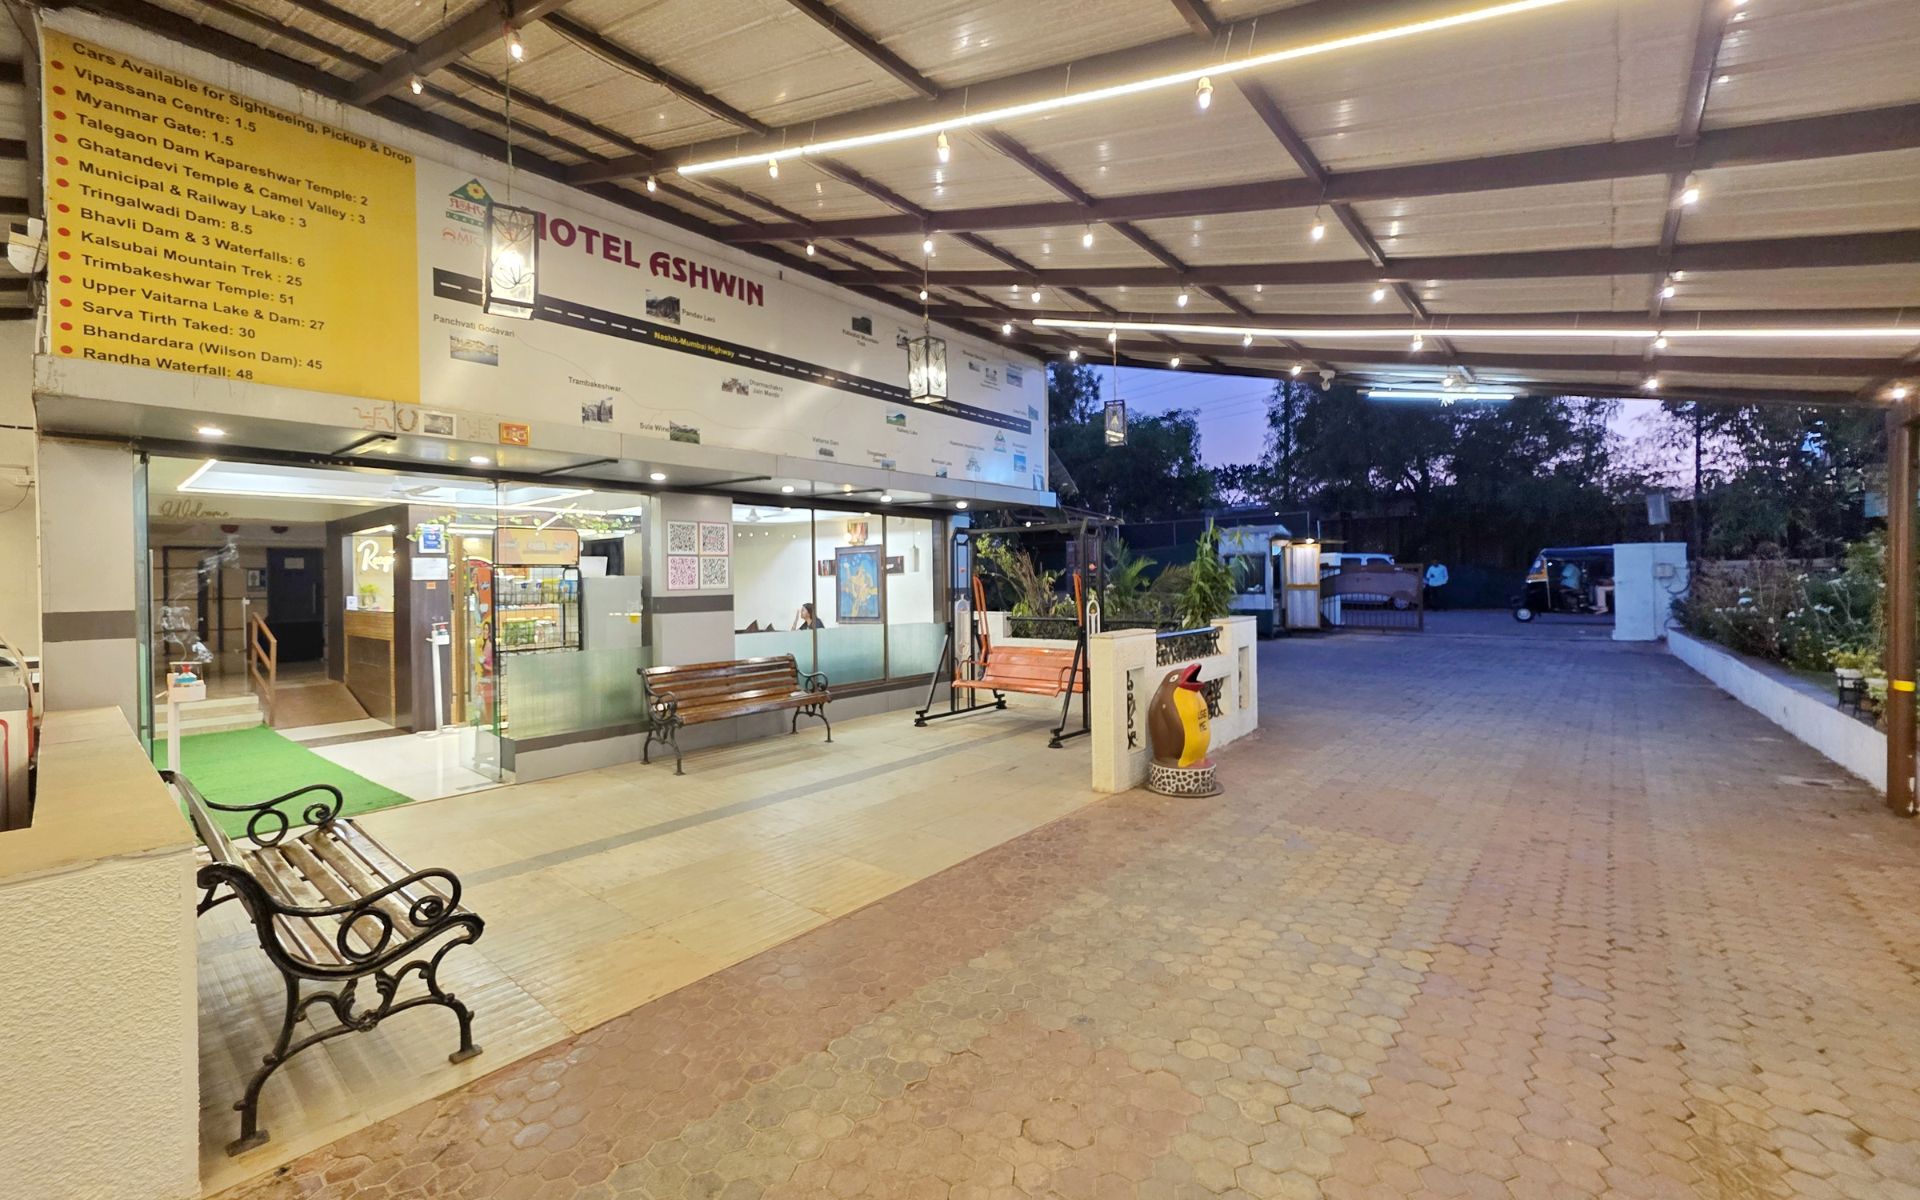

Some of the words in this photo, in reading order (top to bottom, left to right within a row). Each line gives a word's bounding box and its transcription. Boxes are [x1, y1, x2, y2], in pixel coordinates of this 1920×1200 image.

[73, 42, 116, 65] Cars
[121, 59, 198, 92] Available
[202, 86, 225, 101] for
[229, 94, 318, 133] Sightseeing,
[322, 126, 366, 149] Pickup
[370, 142, 379, 152] &
[383, 146, 412, 164] Drop
[74, 66, 167, 104] Vipassana
[172, 98, 229, 124] Centre:
[235, 118, 256, 132] 1.5
[76, 90, 158, 123] Myanmar
[163, 117, 205, 138] Gate:
[212, 132, 233, 146] 1.5
[76, 113, 157, 146] Talegaon
[163, 138, 199, 158] Dam
[205, 150, 301, 186] Kapareshwar
[305, 179, 357, 203] Temple:
[361, 196, 367, 206] 2
[78, 138, 177, 173] Ghatandevi
[183, 166, 239, 190] Temple
[244, 183, 254, 194] &
[259, 187, 303, 207] Camel
[307, 200, 346, 220] Valley
[359, 215, 365, 224] 3
[79, 160, 164, 192] Municipal
[170, 185, 181, 196] &
[187, 189, 246, 214] Railway
[252, 206, 285, 222] Lake
[299, 218, 306, 227] 3
[79, 184, 180, 217] Tringalwadi
[186, 210, 225, 228] Dam:
[231, 221, 252, 234] 8.5
[81, 208, 136, 229] Bhavli
[142, 222, 179, 239] Dam
[185, 232, 196, 243] &
[202, 235, 210, 246] 3
[215, 238, 293, 265] Waterfalls:
[298, 258, 305, 267] 6
[82, 231, 157, 256] Kalsubai
[164, 249, 236, 273] Mountain
[242, 265, 272, 280] Trek
[286, 275, 302, 286] 25
[82, 254, 211, 288] Trimbakeshwar
[216, 281, 274, 302] Temple:
[280, 294, 293, 304] 51
[83, 278, 136, 296] Upper
[141, 288, 207, 309] Vaitarna
[214, 302, 248, 316] Lake
[254, 309, 264, 319] &
[269, 312, 305, 328] Dam:
[310, 320, 324, 329] 27
[650, 251, 764, 307] ASHWIN
[83, 301, 133, 319] Sarva
[139, 310, 176, 326] Tirth
[183, 318, 233, 335] Taked:
[240, 327, 255, 338] 30
[84, 325, 193, 350] Bhandardara
[199, 343, 255, 359] (Wilson
[261, 352, 302, 368] Dam):
[307, 360, 322, 369] 45
[433, 313, 476, 329] Panchvati
[478, 323, 516, 338] Godavari
[84, 348, 150, 366] Randha
[156, 358, 231, 378] Waterfall:
[236, 369, 252, 379] 48
[707, 345, 735, 358] Highway
